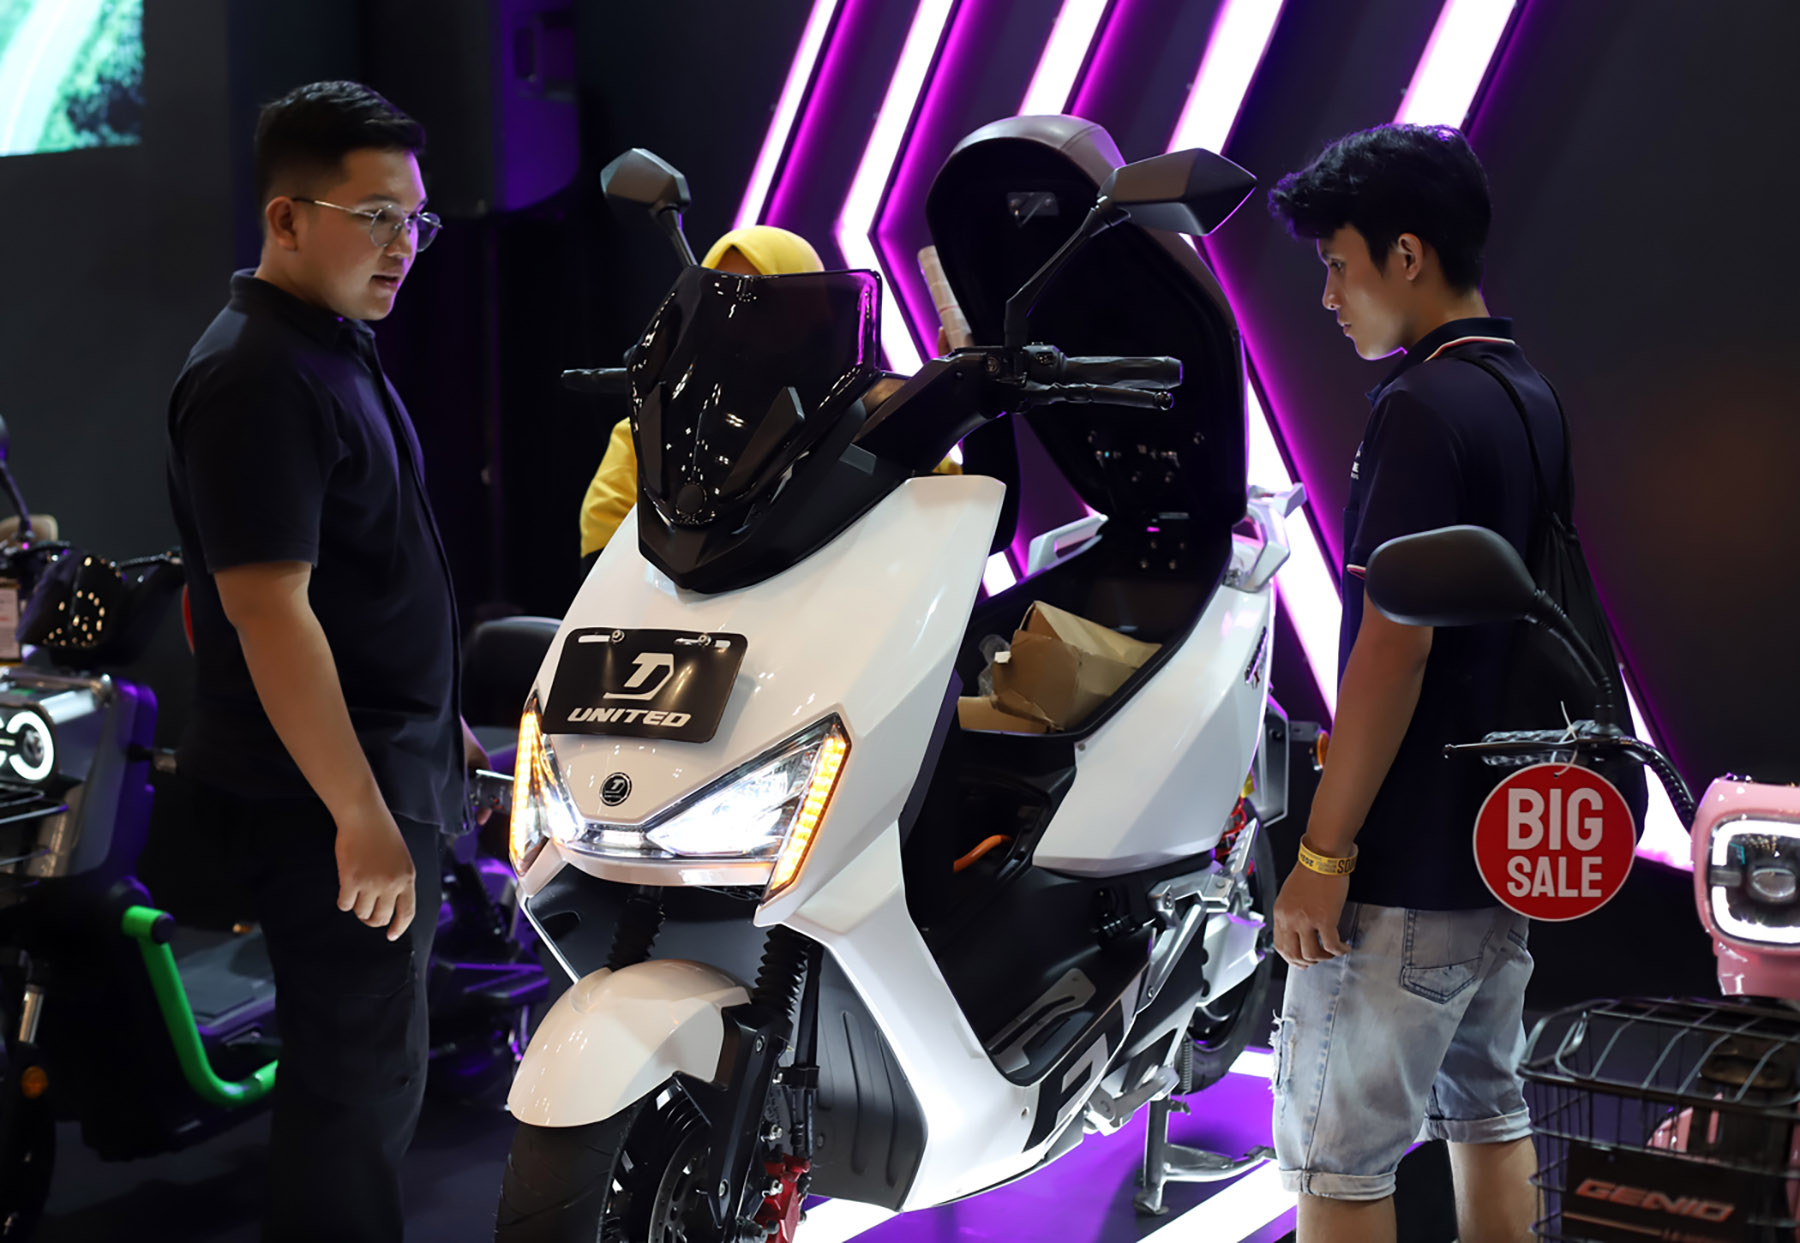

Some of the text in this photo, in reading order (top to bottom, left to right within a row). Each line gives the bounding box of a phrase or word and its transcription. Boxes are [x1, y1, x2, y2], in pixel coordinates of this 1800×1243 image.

[567, 707, 691, 728] UNITED
[1507, 787, 1603, 852] BIG
[1507, 855, 1603, 898] SALE
[1575, 1179, 1735, 1223] GENIO
